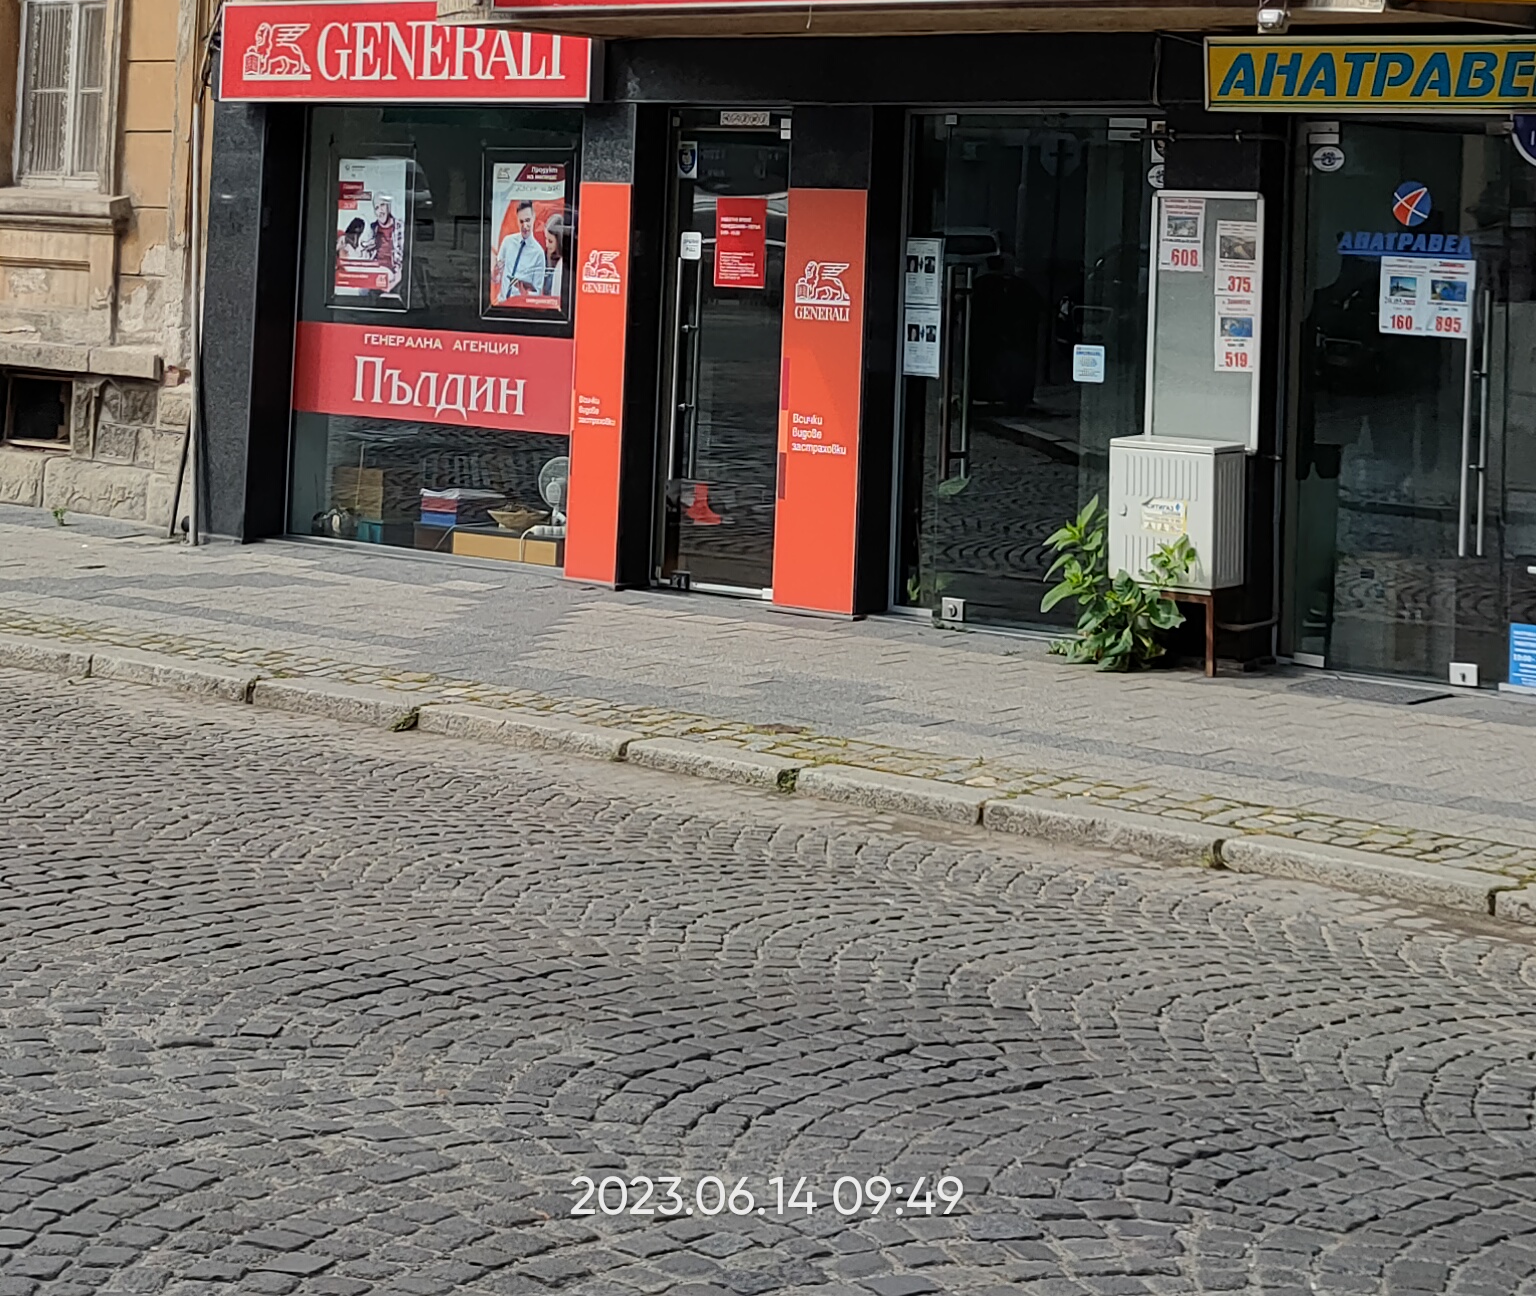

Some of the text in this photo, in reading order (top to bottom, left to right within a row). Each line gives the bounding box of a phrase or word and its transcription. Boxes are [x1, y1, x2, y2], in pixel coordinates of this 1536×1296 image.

[316, 20, 567, 82] GENERALI
[1170, 248, 1199, 267] 608
[1227, 275, 1252, 293] 375
[794, 305, 850, 322] GENERALI
[1390, 314, 1413, 331] 160
[1435, 315, 1463, 333] 895
[363, 333, 520, 356] ГЕНЕРАЛНА АГЕНЦИЯ
[1225, 351, 1248, 368] 519
[791, 441, 847, 455] застраховки
